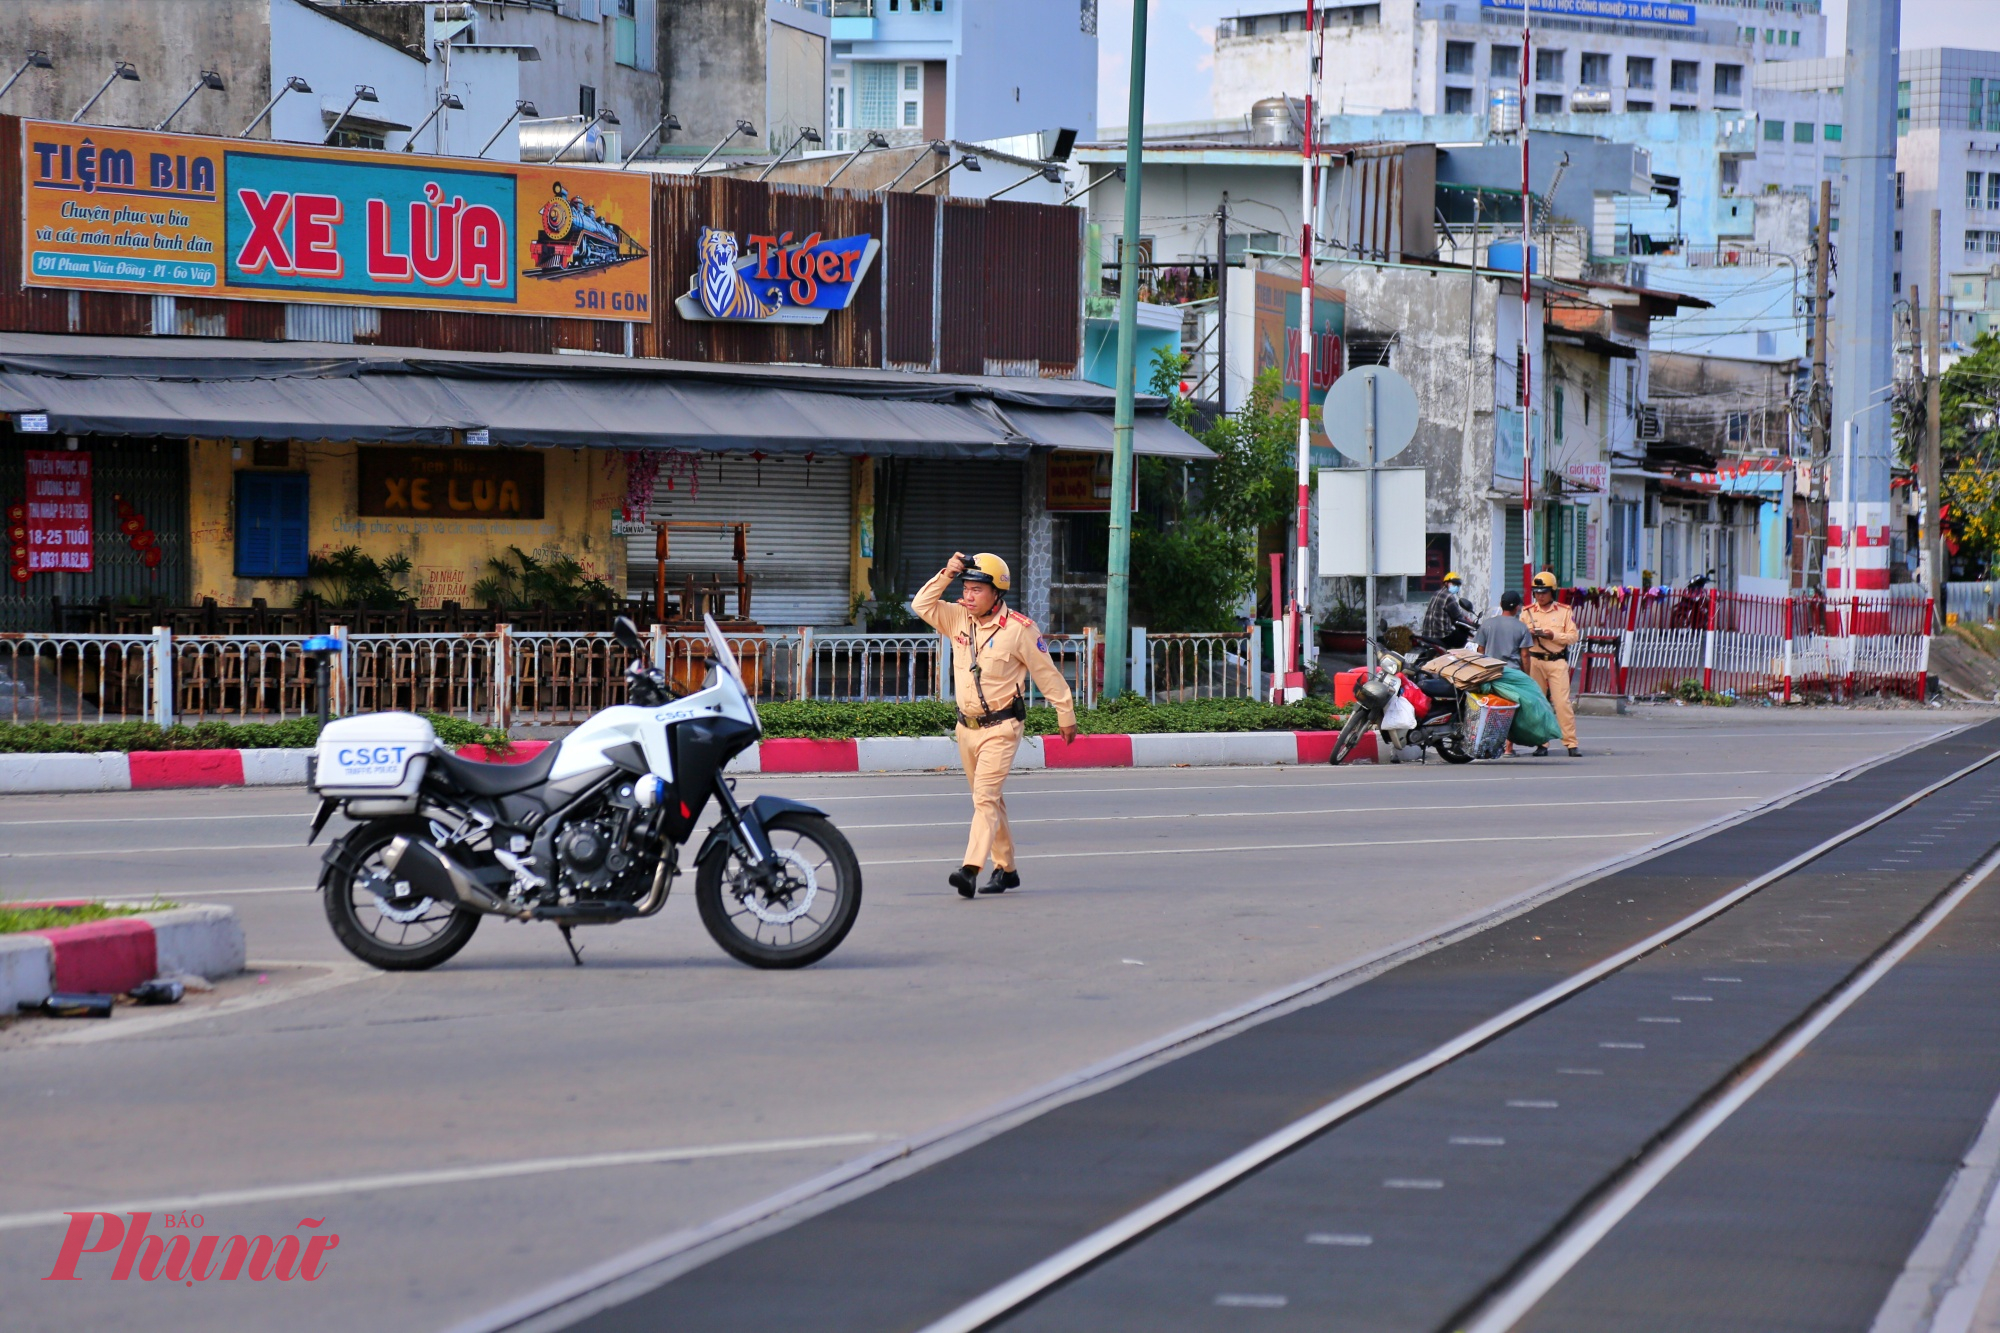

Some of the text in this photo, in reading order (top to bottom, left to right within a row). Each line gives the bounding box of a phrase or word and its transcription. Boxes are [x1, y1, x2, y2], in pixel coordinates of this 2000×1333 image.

[1575, 0, 1598, 13] CÔNG
[1599, 1, 1627, 17] NGHIỆP
[1629, 4, 1640, 17] TP.
[1641, 3, 1652, 18] HỒ
[1653, 5, 1668, 19] CHÍ
[1668, 8, 1689, 21] MINH
[33, 137, 216, 194] TIỆM BIA
[61, 201, 190, 227] Chuyên phục vụ bia
[36, 226, 214, 253] và các món nhậu bình dân
[236, 181, 507, 290] XE LỬA
[37, 256, 56, 271] 191
[57, 259, 90, 274] Phạm
[92, 260, 115, 271] Văn
[115, 261, 146, 279] Đồng
[190, 267, 212, 282] Vấp
[748, 230, 861, 306] Tiger
[1285, 327, 1302, 385] X
[385, 478, 432, 511] XE
[29, 524, 89, 545] 18-25 TUỔI
[655, 710, 694, 722] CSGT
[374, 765, 397, 773] POLICE
